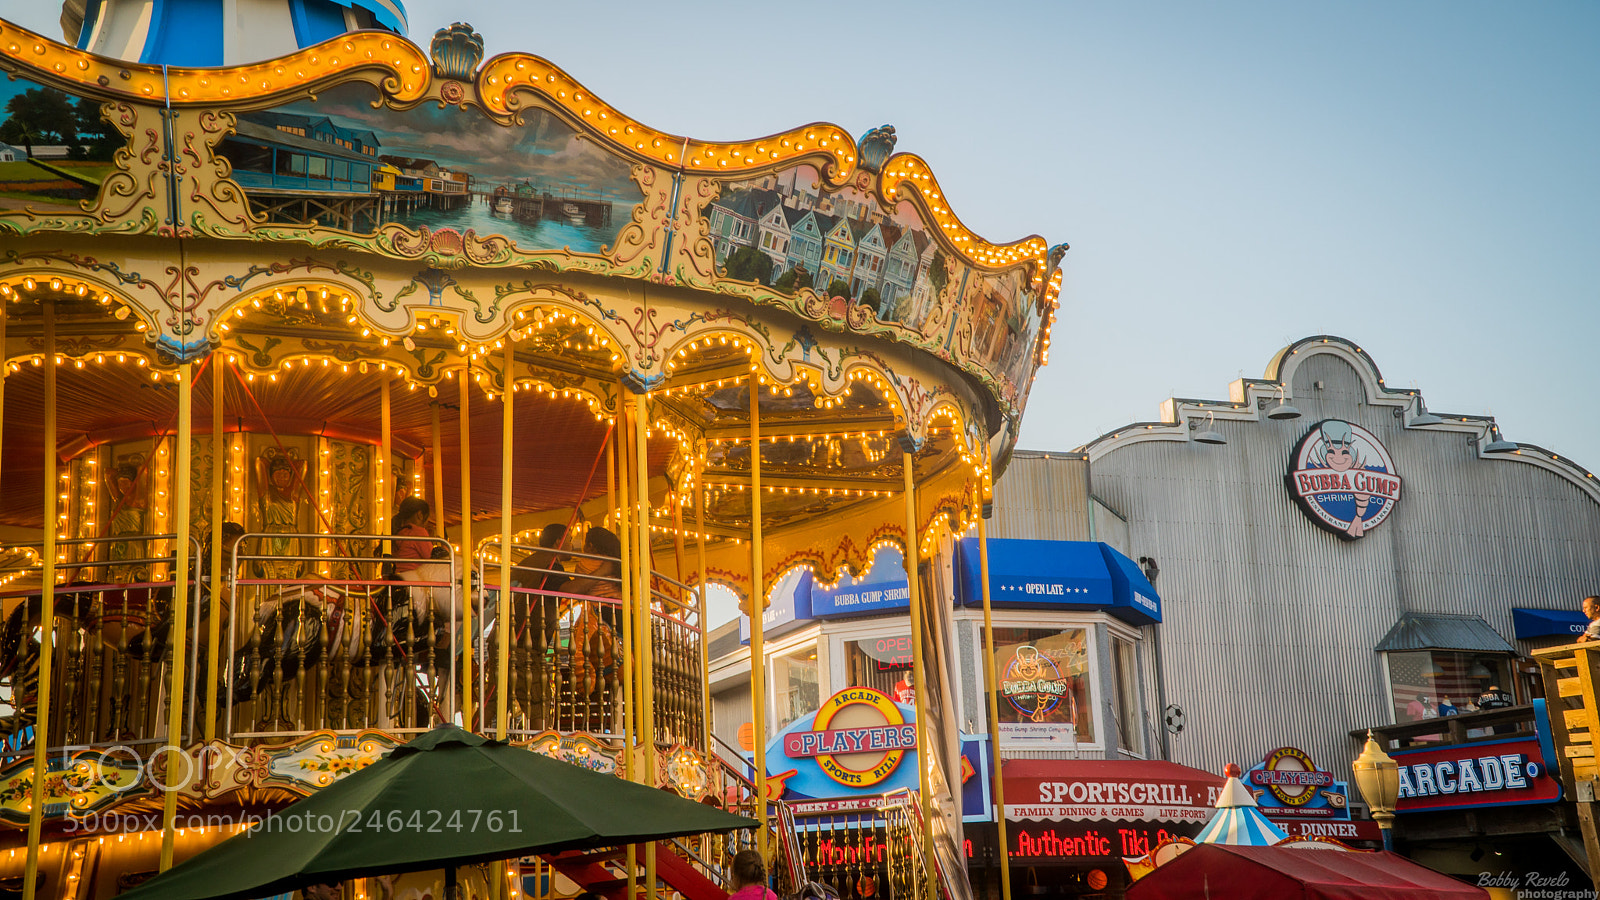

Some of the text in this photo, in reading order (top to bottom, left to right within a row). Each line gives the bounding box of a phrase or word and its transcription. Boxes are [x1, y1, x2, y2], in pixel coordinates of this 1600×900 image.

[1298, 472, 1398, 496] BUBBA GUMP
[1317, 494, 1354, 502] SHRIMP
[1308, 496, 1349, 529] RESTAURANT
[1371, 502, 1392, 525] MARKET
[1025, 583, 1064, 595] OPEN LATE
[834, 593, 860, 606] BUBBA
[861, 591, 883, 603] GUMP
[1003, 680, 1037, 695] BUBBA
[835, 691, 880, 707] ARCADE
[801, 726, 916, 755] PLAYERS
[1274, 748, 1306, 761] ARCADE
[824, 759, 862, 783] SPORTS
[1262, 771, 1324, 785] PLAYERS
[1398, 754, 1527, 798] ARCADE
[1039, 782, 1193, 805] SPORTSGRILL
[1274, 787, 1314, 803] SPORTS GRILL
[796, 803, 829, 813] MEET
[837, 801, 860, 810] EAT
[1014, 808, 1206, 819] FAMILY DINING & GAMES LIVE SPORTS
[1300, 823, 1358, 837] DINNER
[1118, 829, 1149, 855] Tiki
